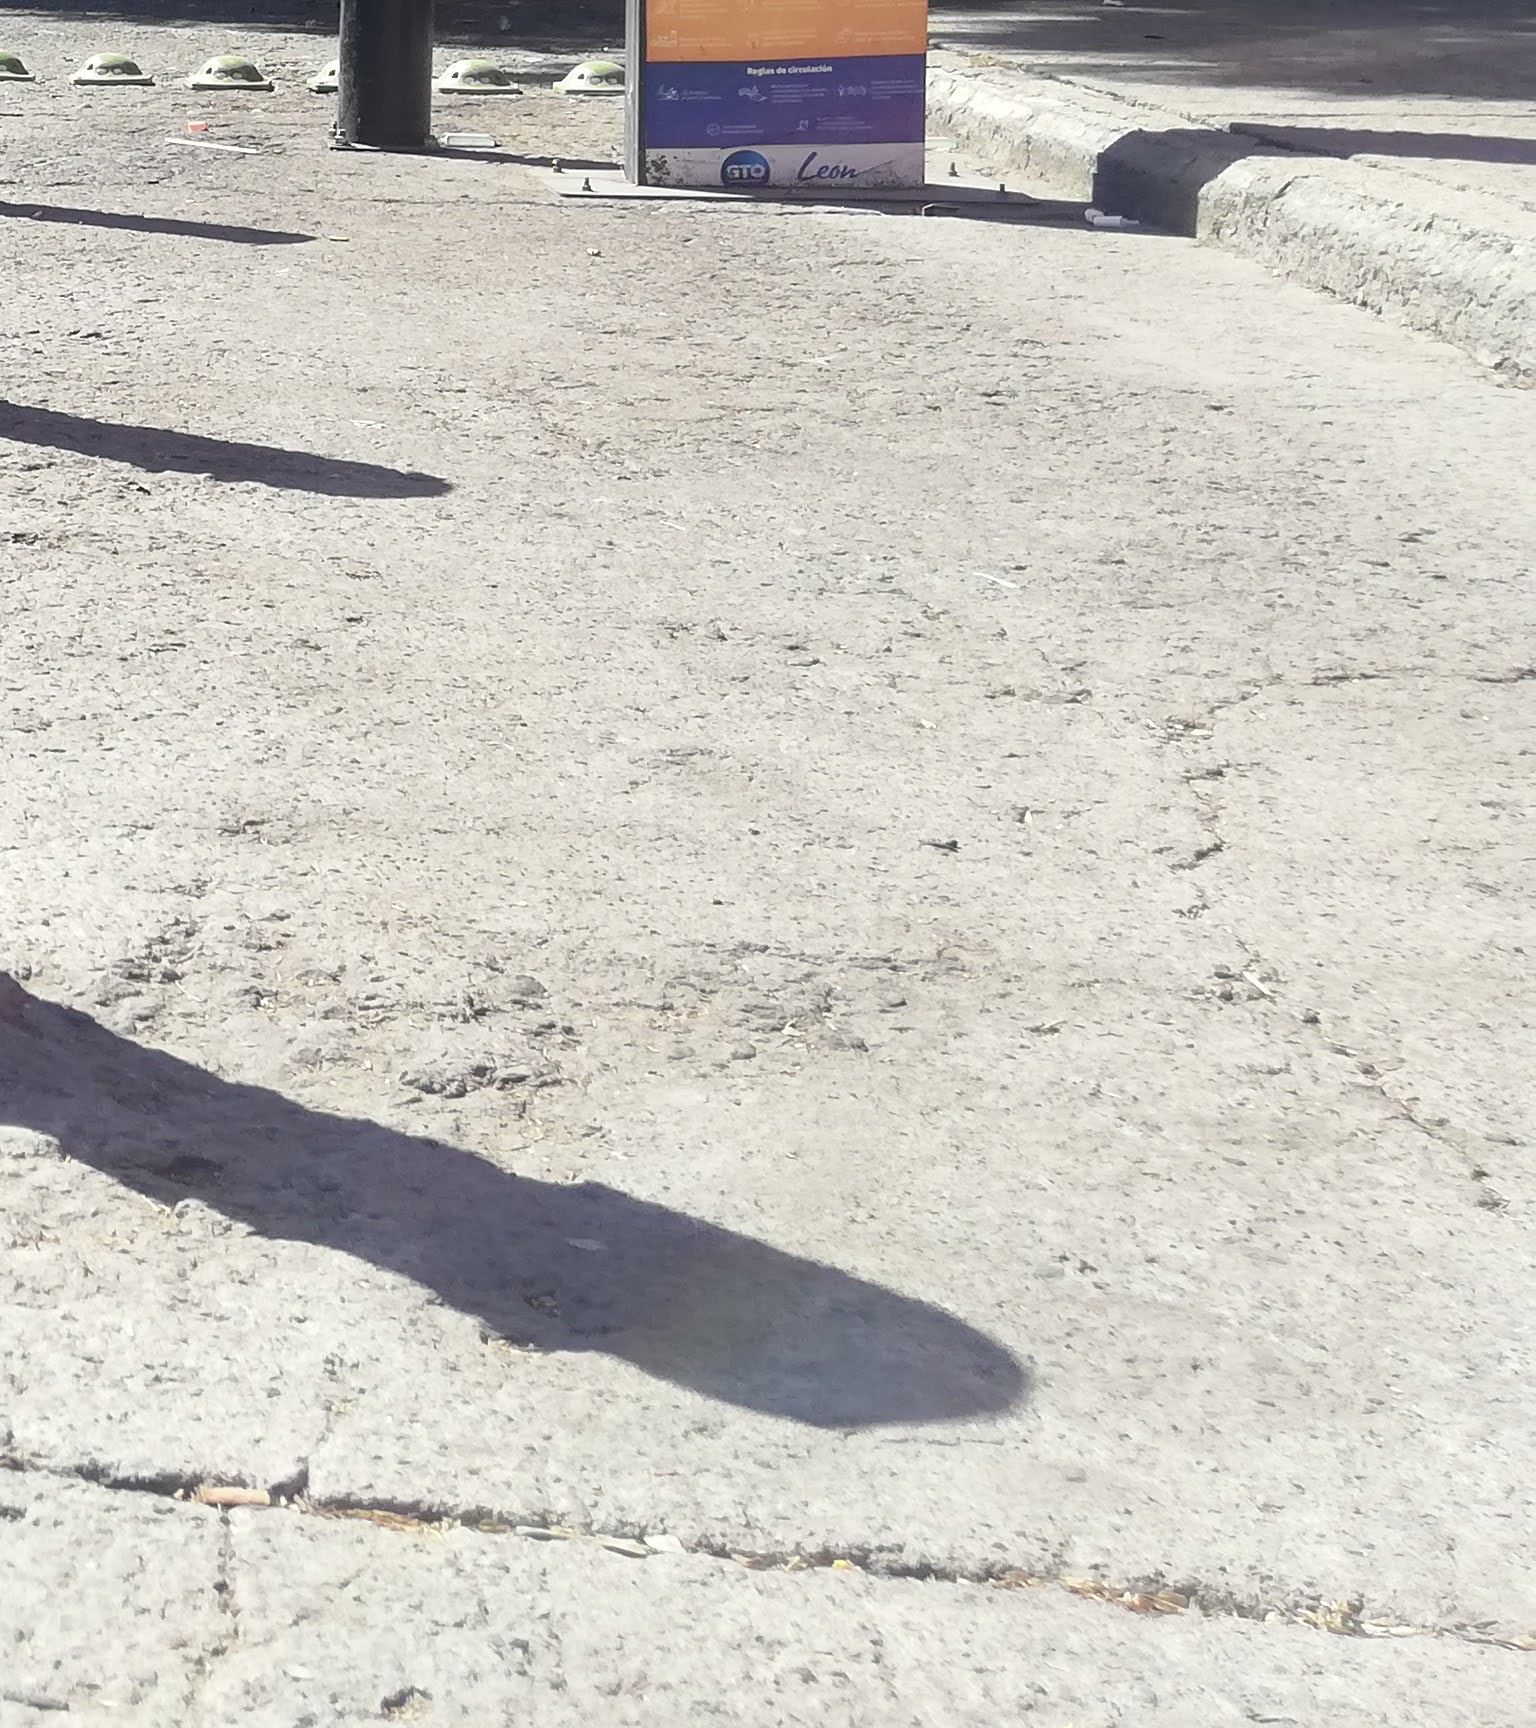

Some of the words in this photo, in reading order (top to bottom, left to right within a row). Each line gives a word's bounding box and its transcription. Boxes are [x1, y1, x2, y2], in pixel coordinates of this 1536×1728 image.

[747, 66, 775, 77] Reglas
[776, 65, 787, 75] de
[788, 63, 833, 75] circulación
[726, 163, 766, 179] GTO
